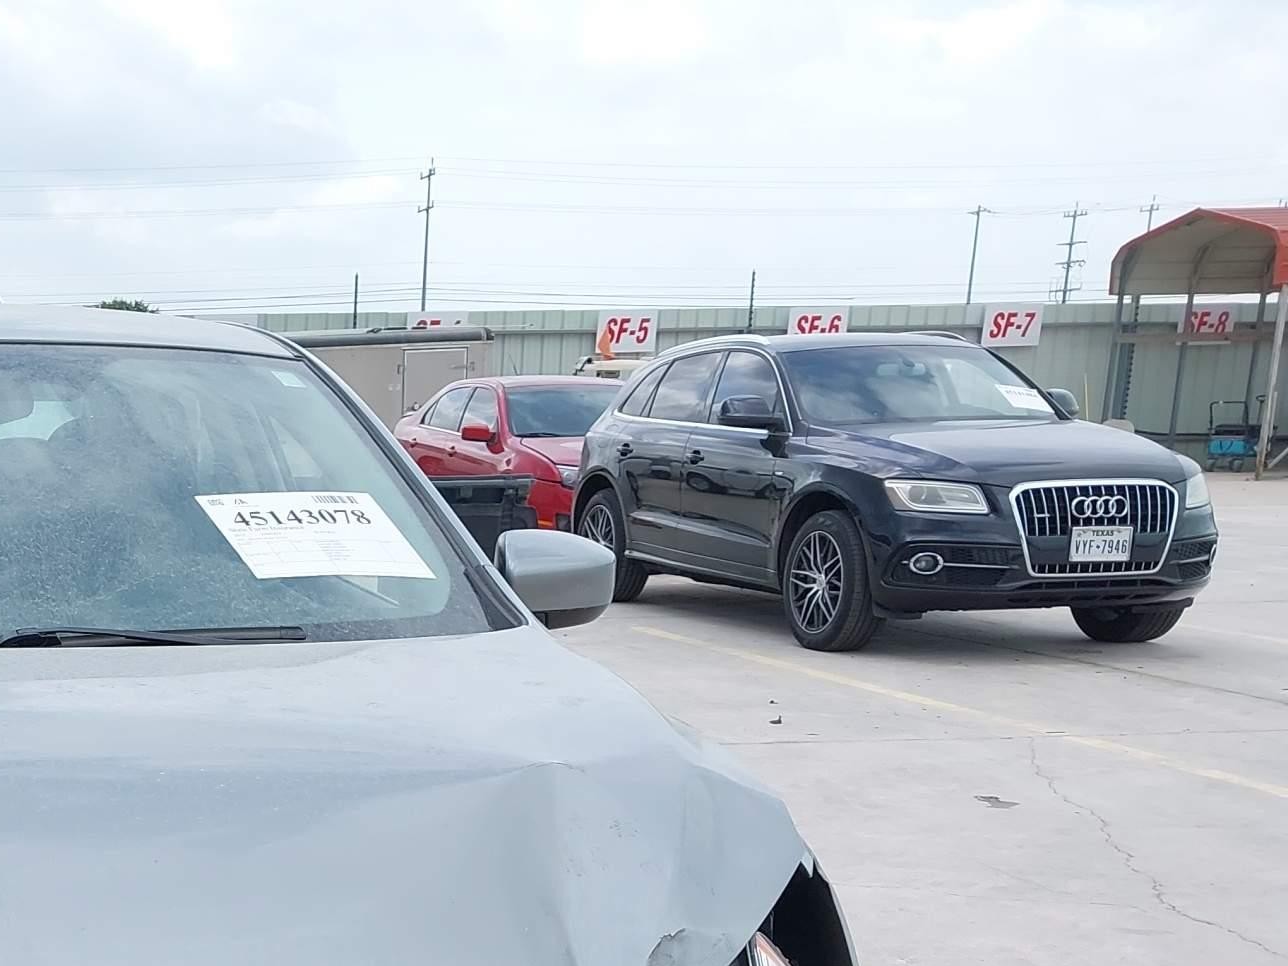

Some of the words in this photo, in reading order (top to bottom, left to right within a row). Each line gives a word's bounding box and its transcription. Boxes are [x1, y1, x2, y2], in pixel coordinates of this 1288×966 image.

[607, 317, 651, 344] SF-5
[989, 312, 1037, 338] SF-7
[233, 509, 372, 527] 45143078
[1092, 529, 1114, 537] TEXAS
